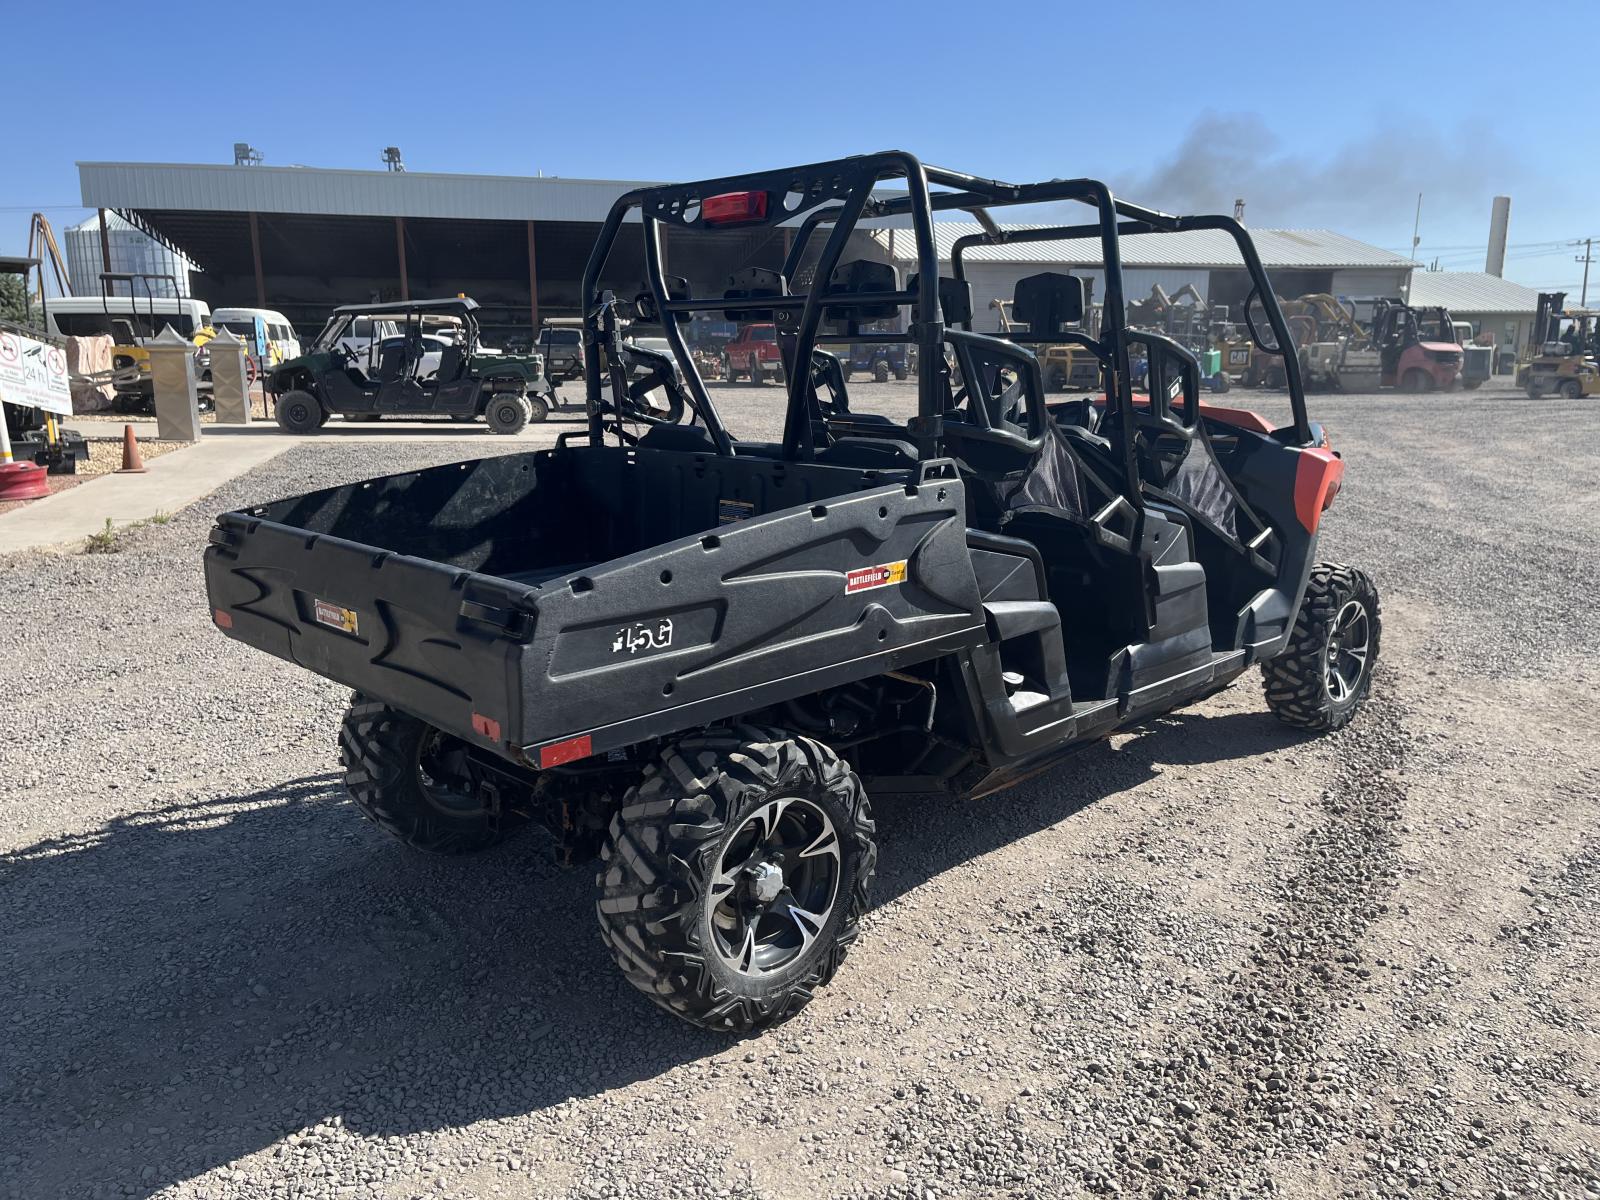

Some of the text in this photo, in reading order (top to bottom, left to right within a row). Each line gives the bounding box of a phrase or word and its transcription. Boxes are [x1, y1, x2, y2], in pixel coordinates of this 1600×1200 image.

[1230, 351, 1248, 364] CAT
[25, 367, 36, 383] 24
[38, 368, 46, 384] h
[849, 572, 882, 587] BATTLEFIELD
